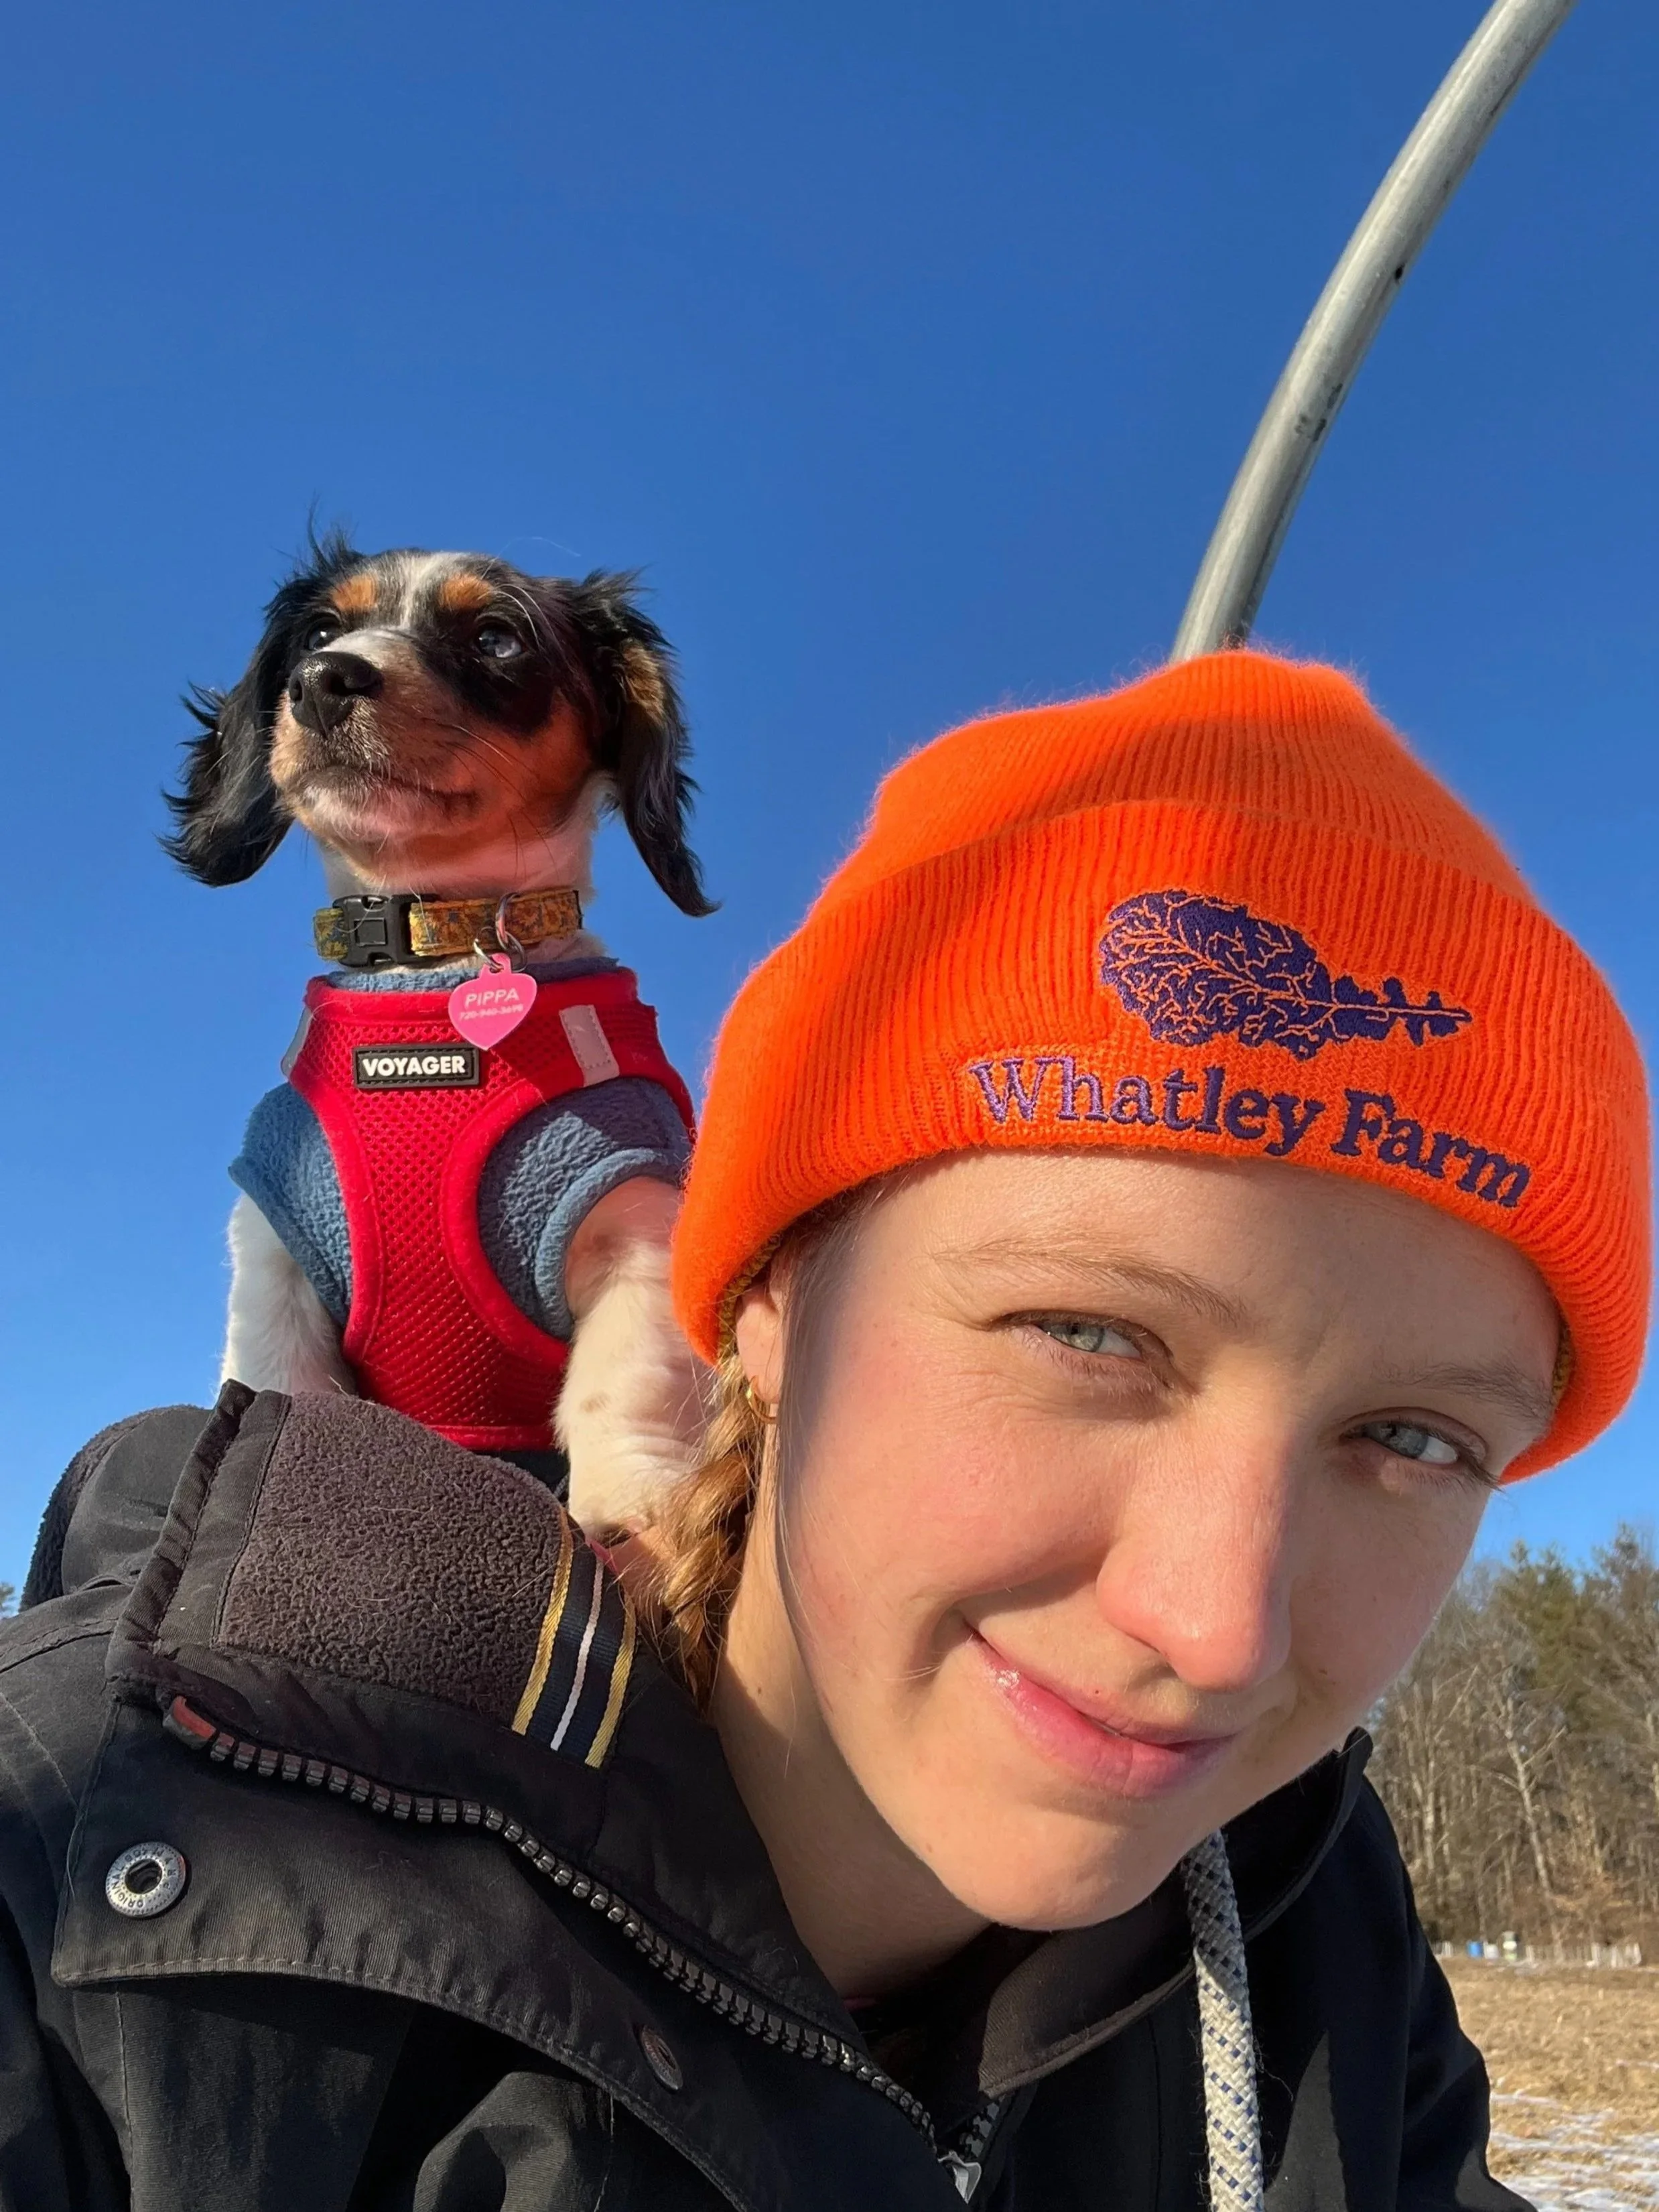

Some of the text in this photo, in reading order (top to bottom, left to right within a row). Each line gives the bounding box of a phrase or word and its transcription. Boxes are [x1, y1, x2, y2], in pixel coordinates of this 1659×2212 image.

[464, 987, 520, 1009] PIPPA
[362, 1055, 466, 1077] VOYAGER
[968, 1056, 1532, 1207] Whatley Farm
